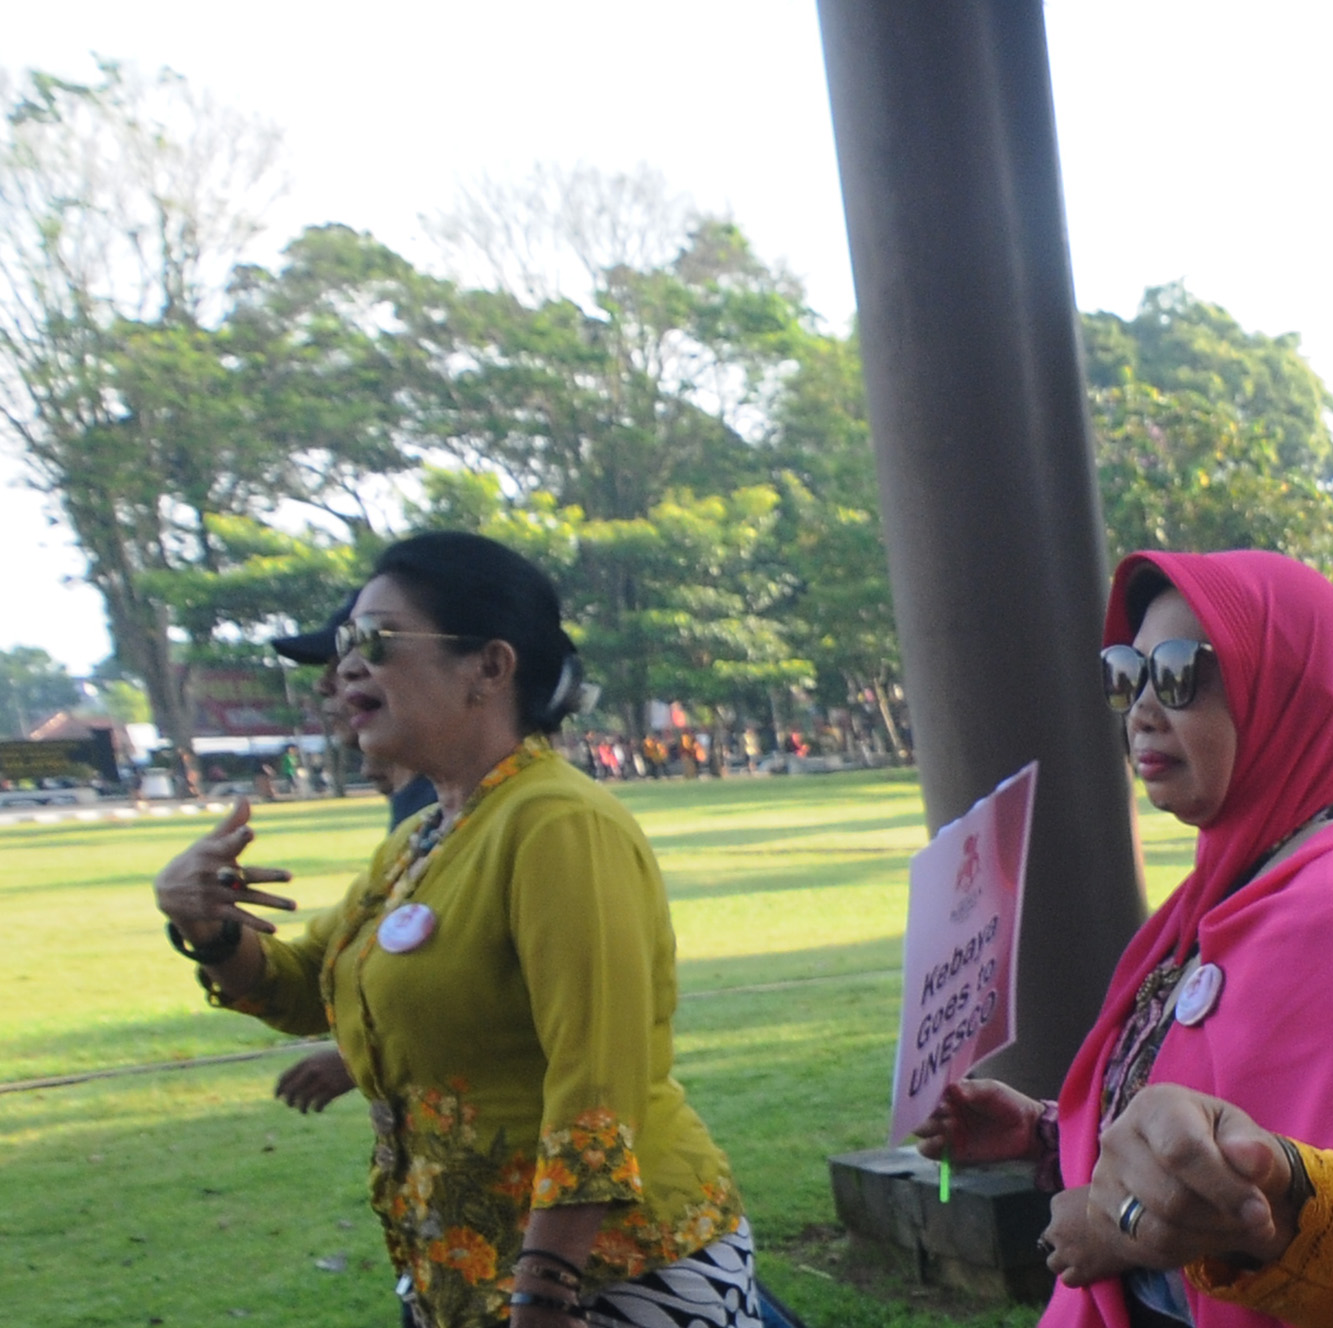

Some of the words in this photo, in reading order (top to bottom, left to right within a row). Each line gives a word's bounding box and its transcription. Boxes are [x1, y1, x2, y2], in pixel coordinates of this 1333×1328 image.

[916, 983, 970, 1049] Goes
[977, 958, 995, 991] to
[921, 915, 998, 1005] Kebaya
[909, 990, 996, 1097] UNESCO
